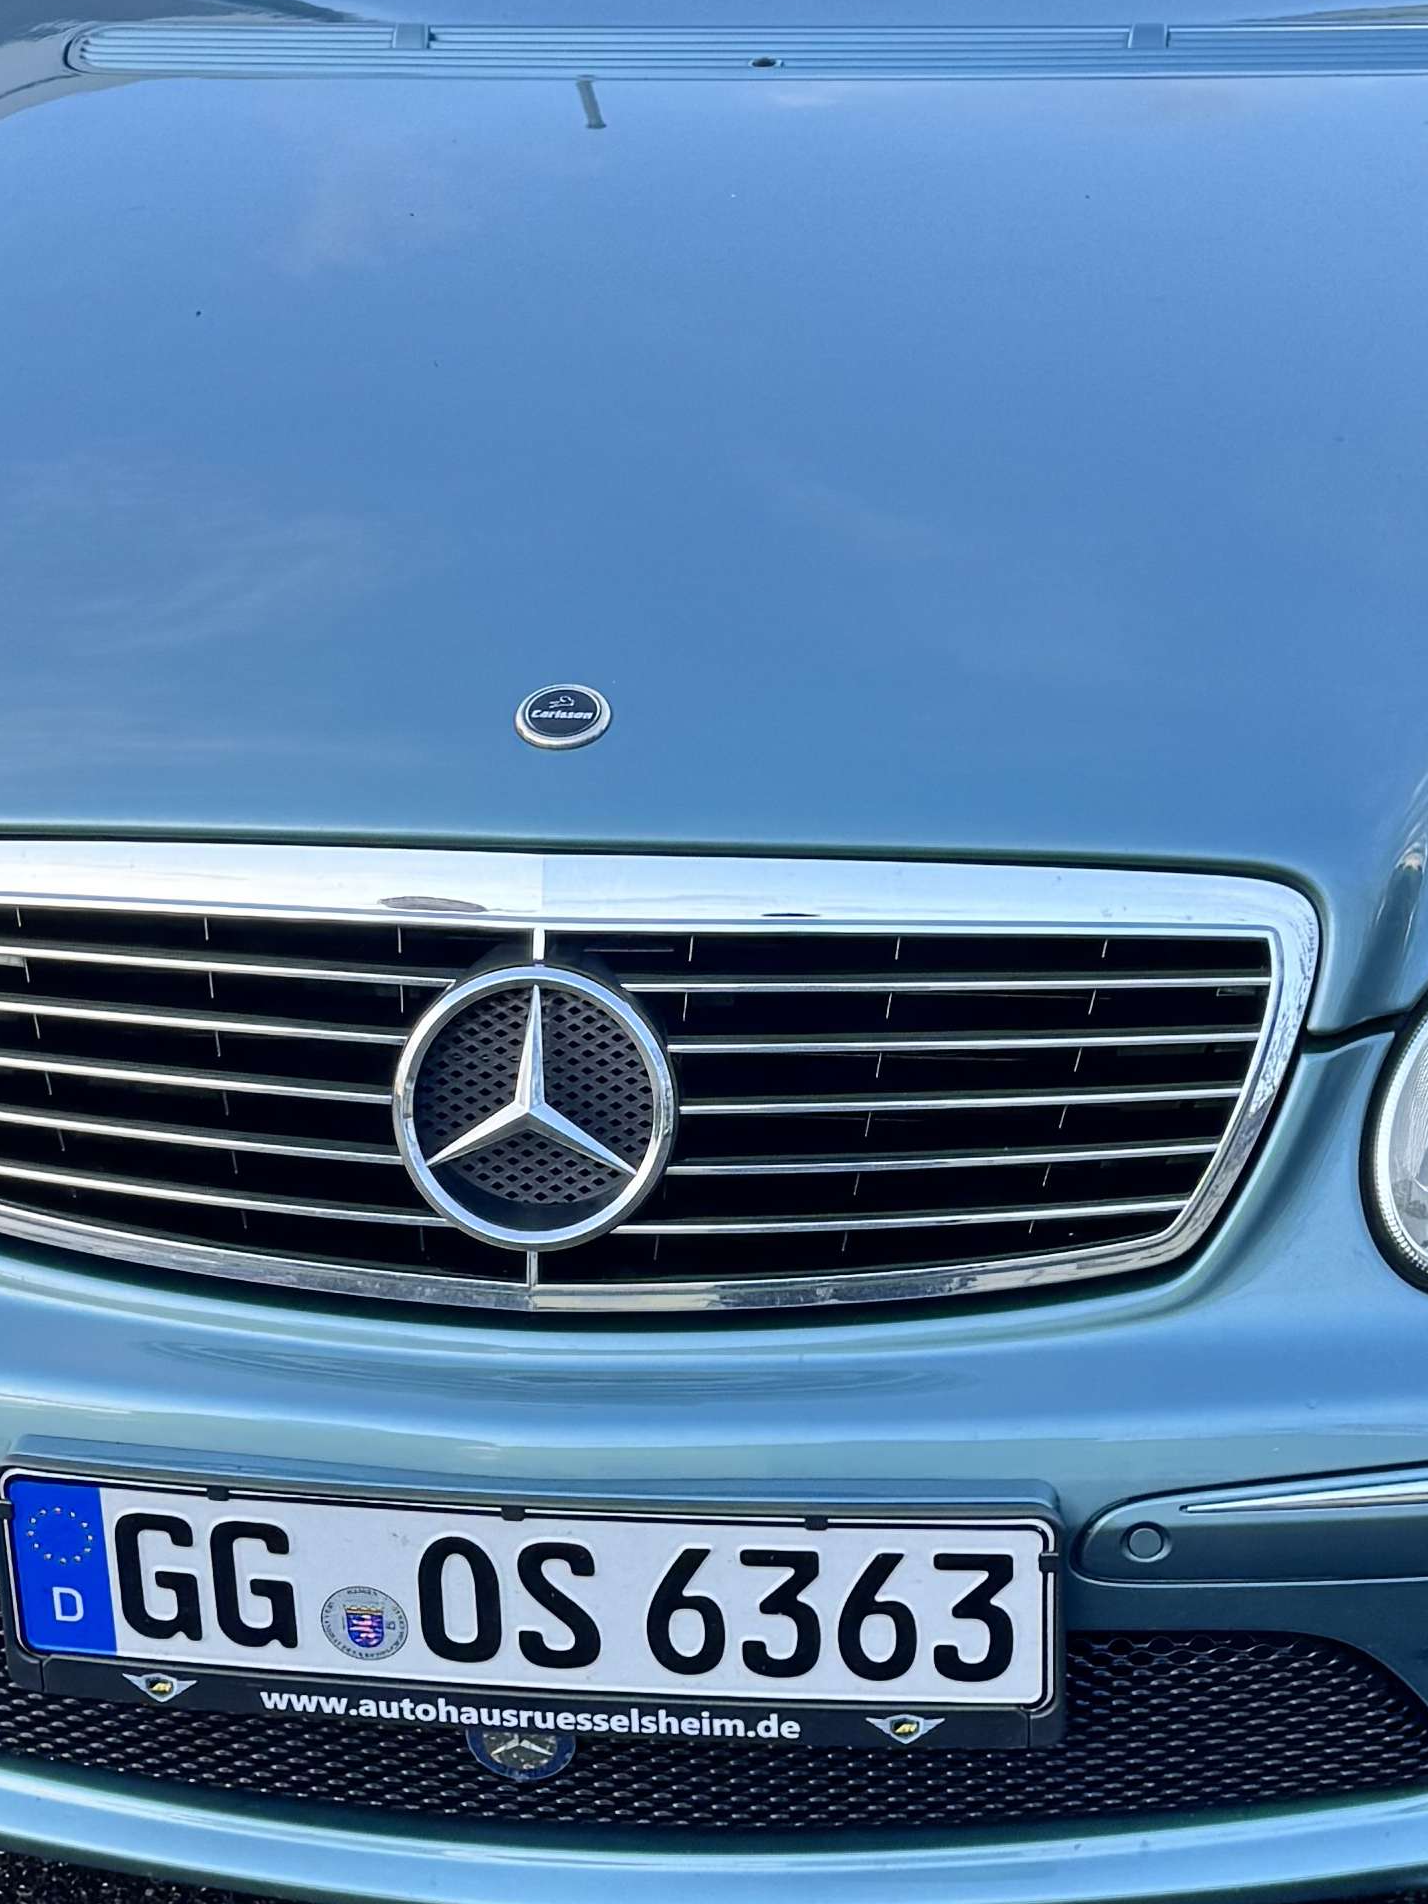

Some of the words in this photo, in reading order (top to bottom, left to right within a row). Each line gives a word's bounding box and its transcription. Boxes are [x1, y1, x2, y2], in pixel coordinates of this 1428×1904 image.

[530, 709, 594, 720] Carlsson
[52, 1587, 84, 1622] D
[114, 1512, 299, 1648] GG
[417, 1536, 602, 1669] OS
[646, 1548, 1015, 1683] 6363
[259, 1691, 801, 1739] www.autohausruesselsheim.de
